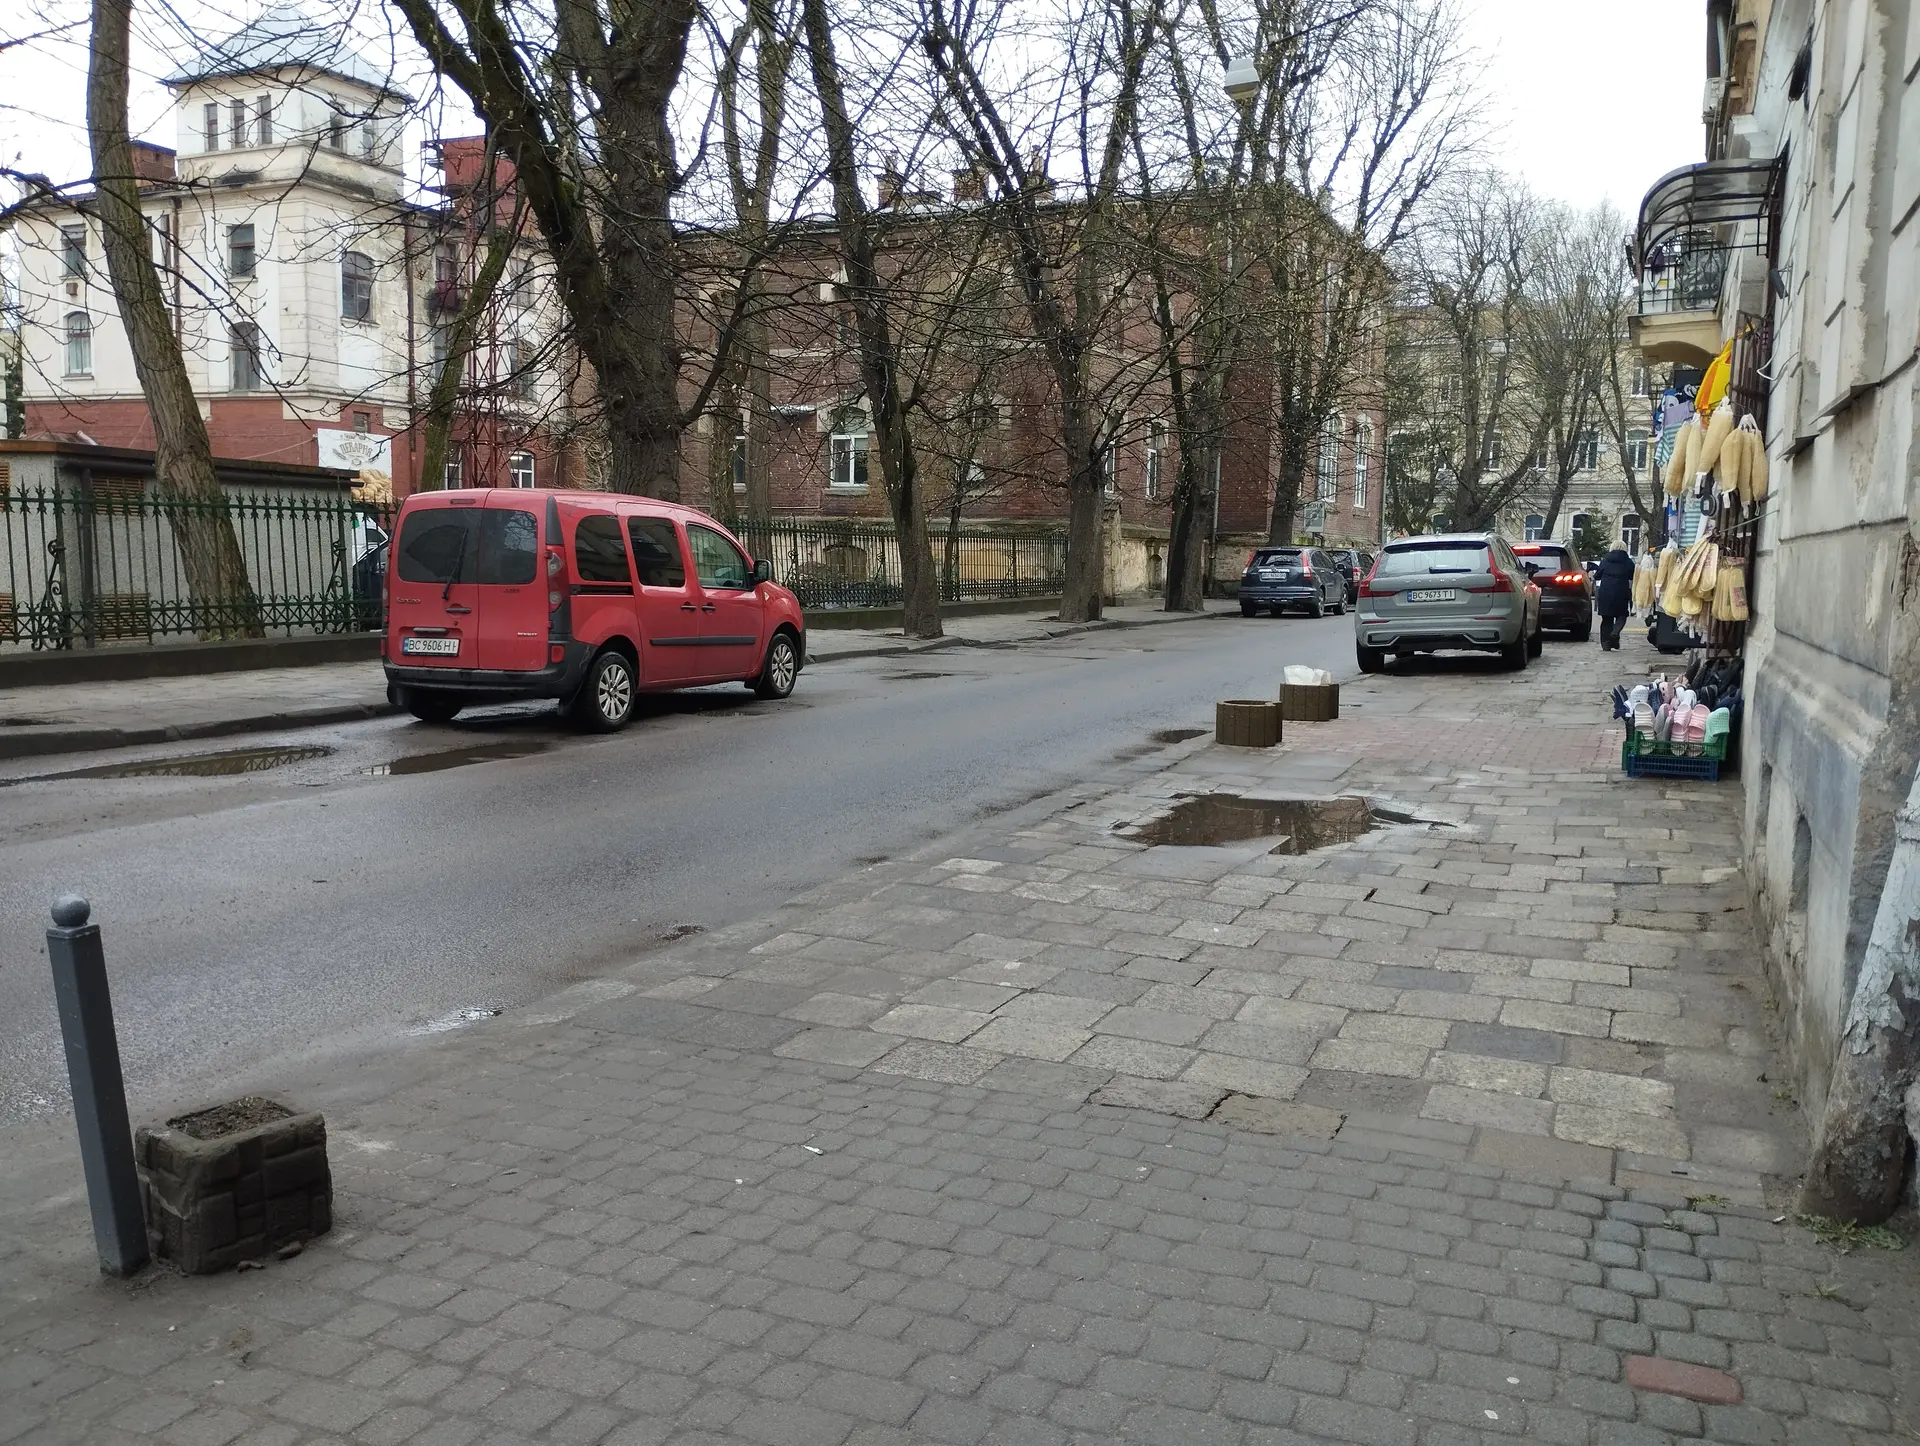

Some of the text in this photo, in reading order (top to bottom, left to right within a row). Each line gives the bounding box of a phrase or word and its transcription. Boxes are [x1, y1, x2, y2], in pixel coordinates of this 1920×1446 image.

[339, 441, 373, 457] ПЕКАРНЯ
[1412, 591, 1423, 599] BC
[1424, 590, 1441, 598] 9673
[408, 640, 422, 651] BC
[422, 640, 443, 651] 9606
